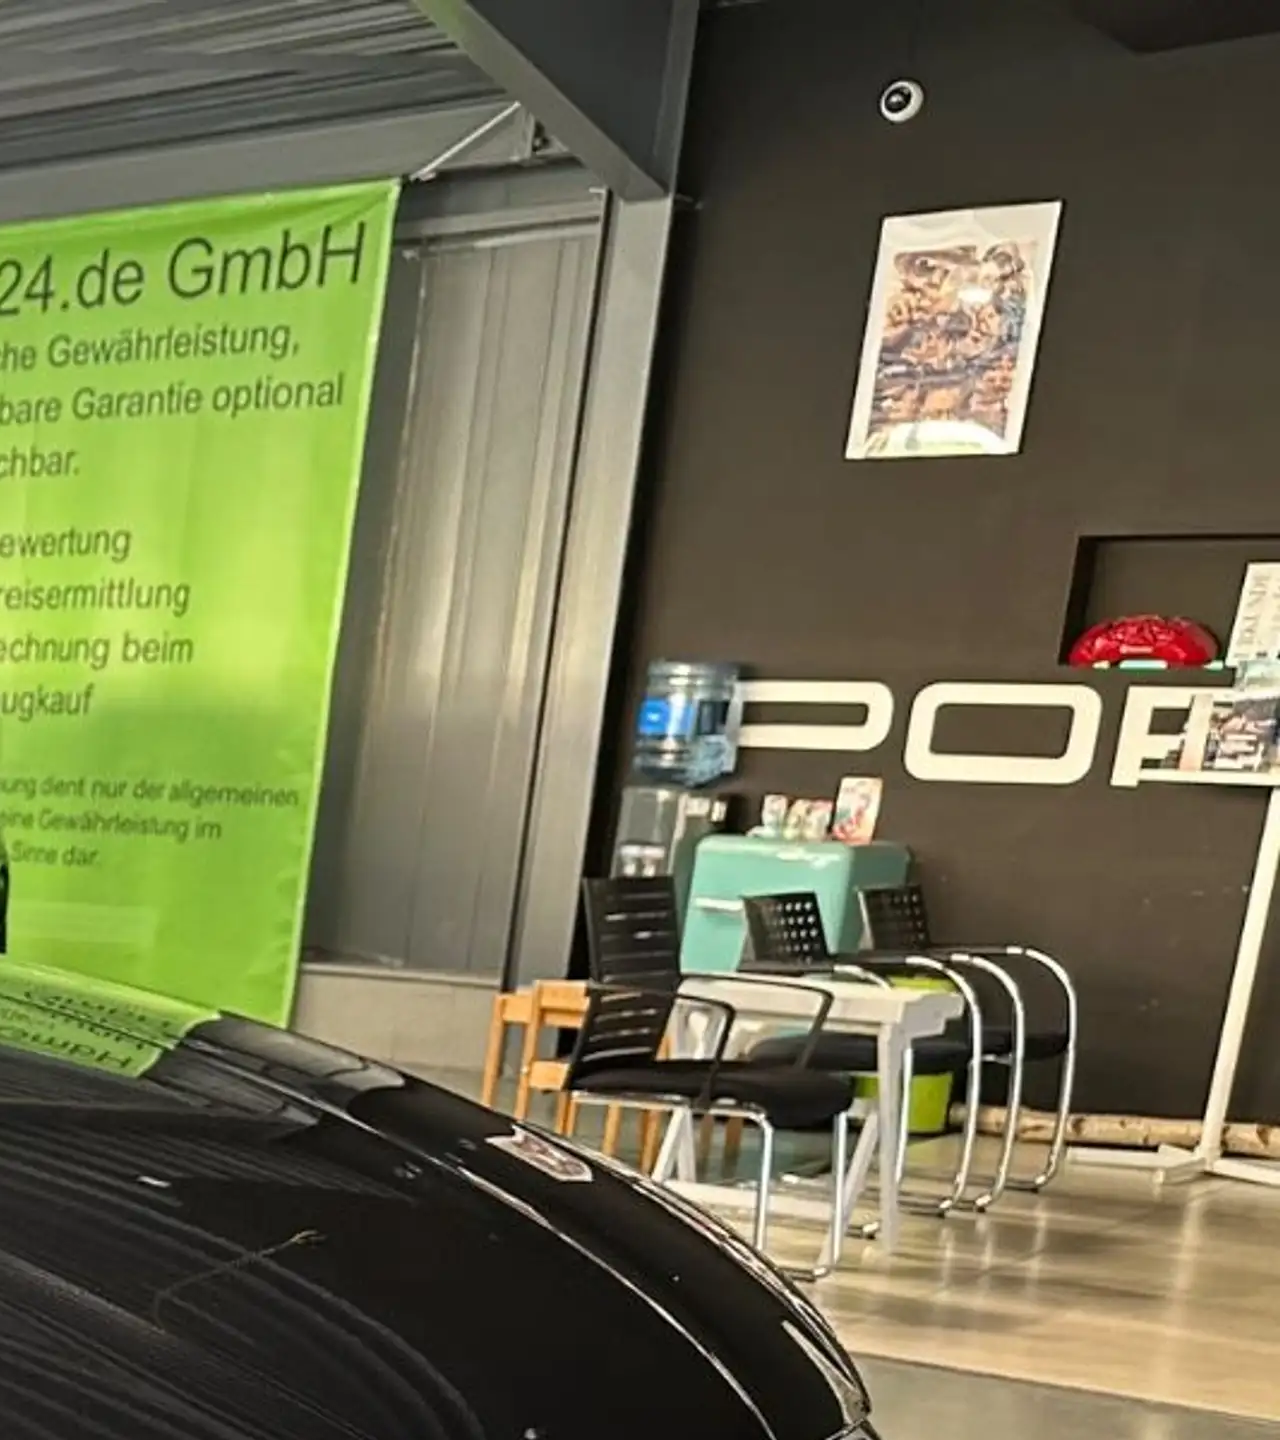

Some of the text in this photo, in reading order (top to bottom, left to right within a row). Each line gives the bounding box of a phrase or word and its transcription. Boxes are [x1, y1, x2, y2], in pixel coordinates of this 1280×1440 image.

[168, 221, 366, 299] GmbH
[47, 323, 299, 369] Gewährleistung,
[72, 380, 203, 421] Garantie
[211, 371, 344, 420] optional
[121, 630, 195, 664] beim
[91, 778, 128, 798] nur
[132, 778, 166, 800] der
[168, 779, 300, 808] allgemeinen
[194, 815, 223, 840] im
